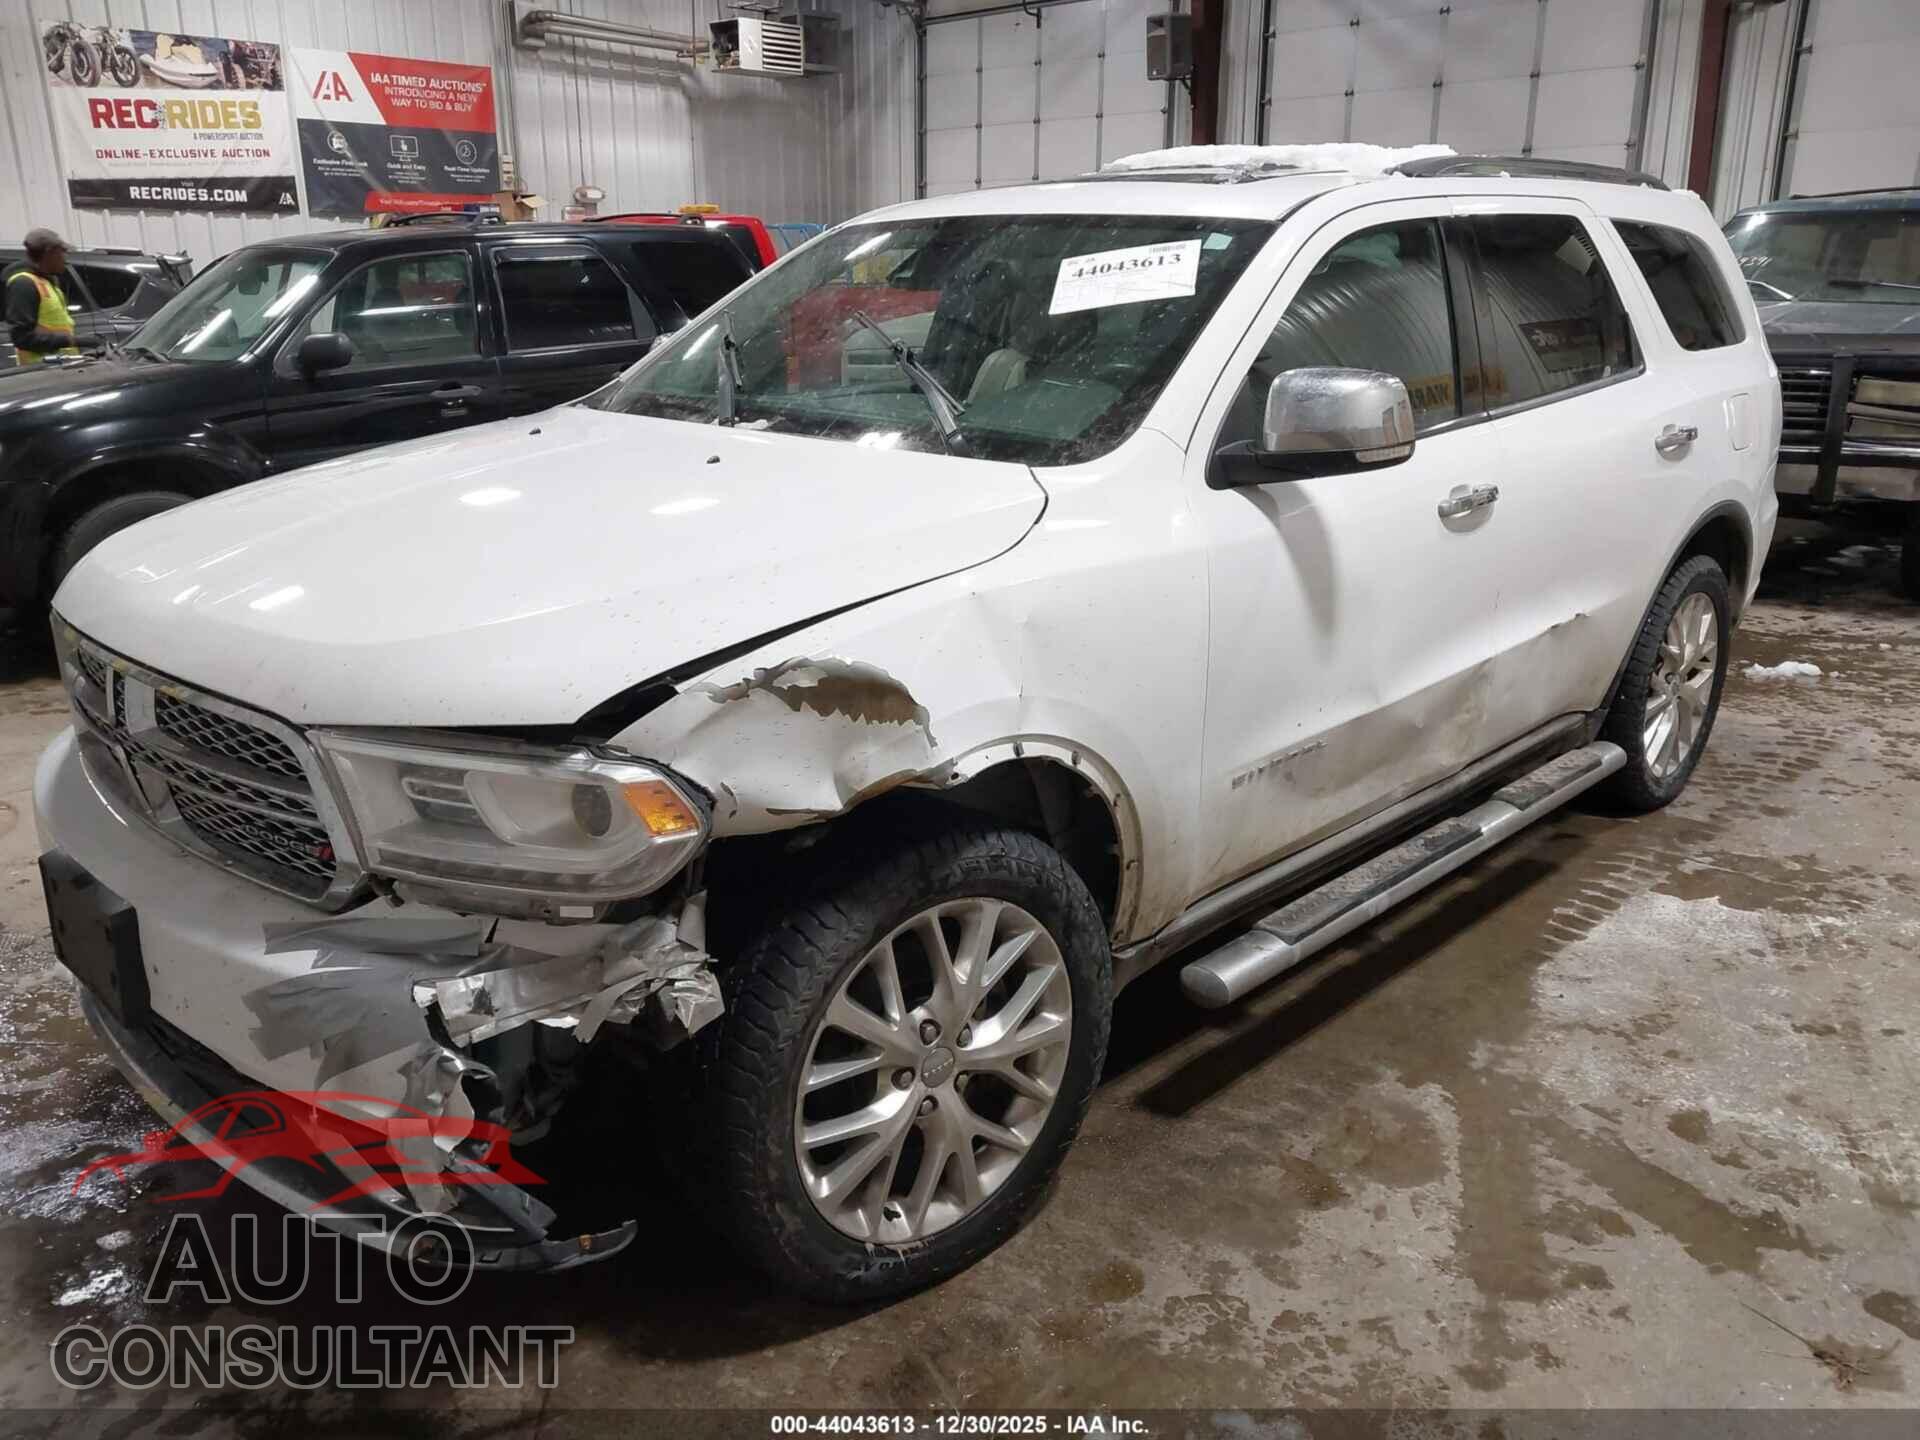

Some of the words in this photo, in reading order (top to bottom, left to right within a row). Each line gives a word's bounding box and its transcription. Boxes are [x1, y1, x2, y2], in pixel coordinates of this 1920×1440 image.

[370, 72, 390, 84] IAA
[391, 74, 426, 88] TIMED
[385, 86, 446, 100] INTRODUCING
[448, 92, 455, 100] A
[456, 93, 478, 103] NEW
[391, 98, 412, 107] WAY
[415, 99, 428, 109] TO
[429, 100, 443, 110] BID
[454, 102, 473, 112] BUY
[88, 98, 160, 129] REC
[164, 98, 262, 129] RIDES
[239, 133, 264, 141] AUCTION
[96, 147, 217, 160] ONLINE-EXCLUSIVE
[221, 148, 271, 158] AUCTION
[129, 186, 248, 203] RECRIDES.COM
[1071, 253, 1182, 279] 44043613
